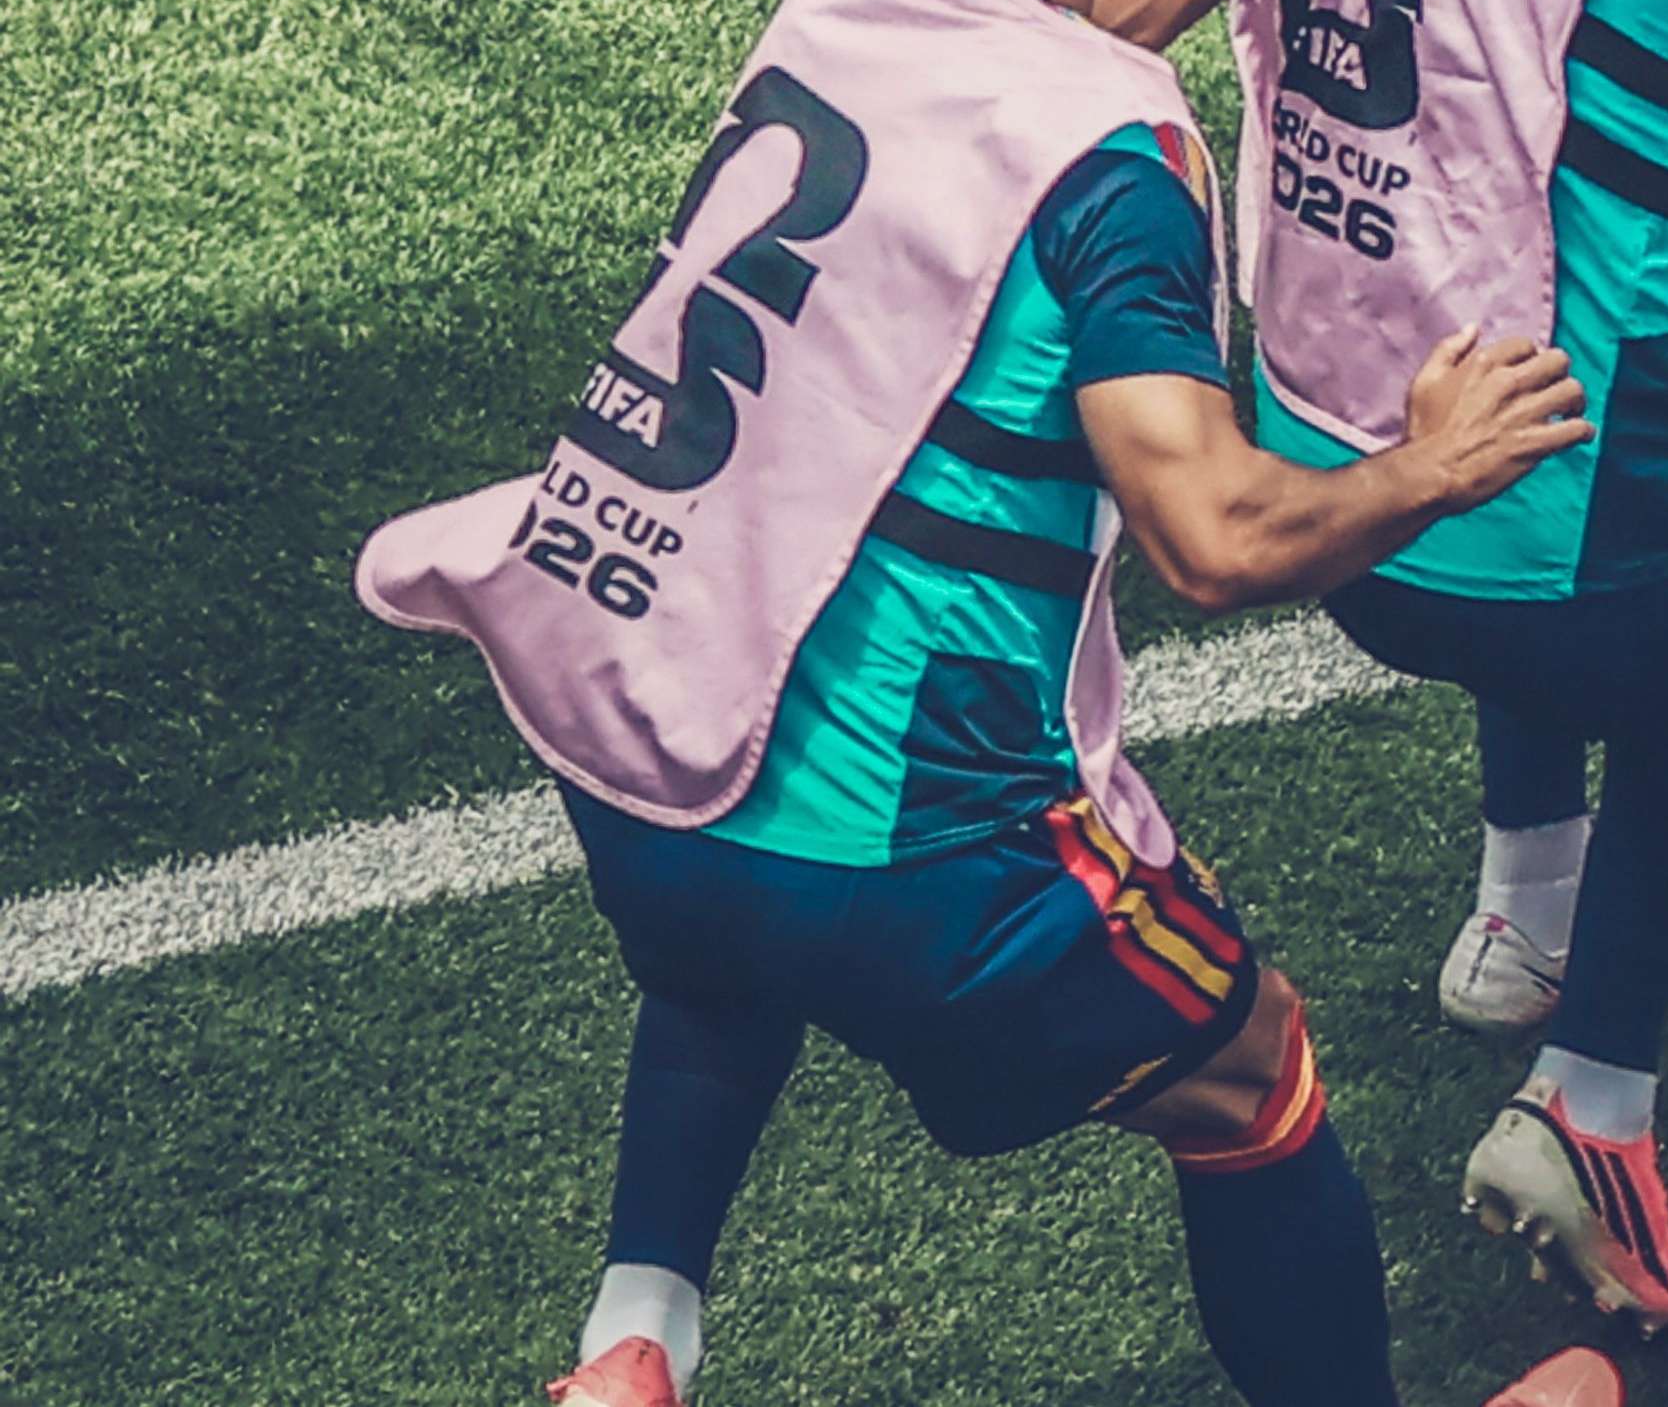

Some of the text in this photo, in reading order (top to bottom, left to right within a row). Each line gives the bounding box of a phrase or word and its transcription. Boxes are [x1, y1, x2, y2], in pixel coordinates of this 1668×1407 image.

[1292, 25, 1368, 91] IFA
[1272, 146, 1397, 261] 026
[1336, 144, 1411, 197] CUP
[508, 498, 658, 621] 26
[595, 496, 684, 558] CUP
